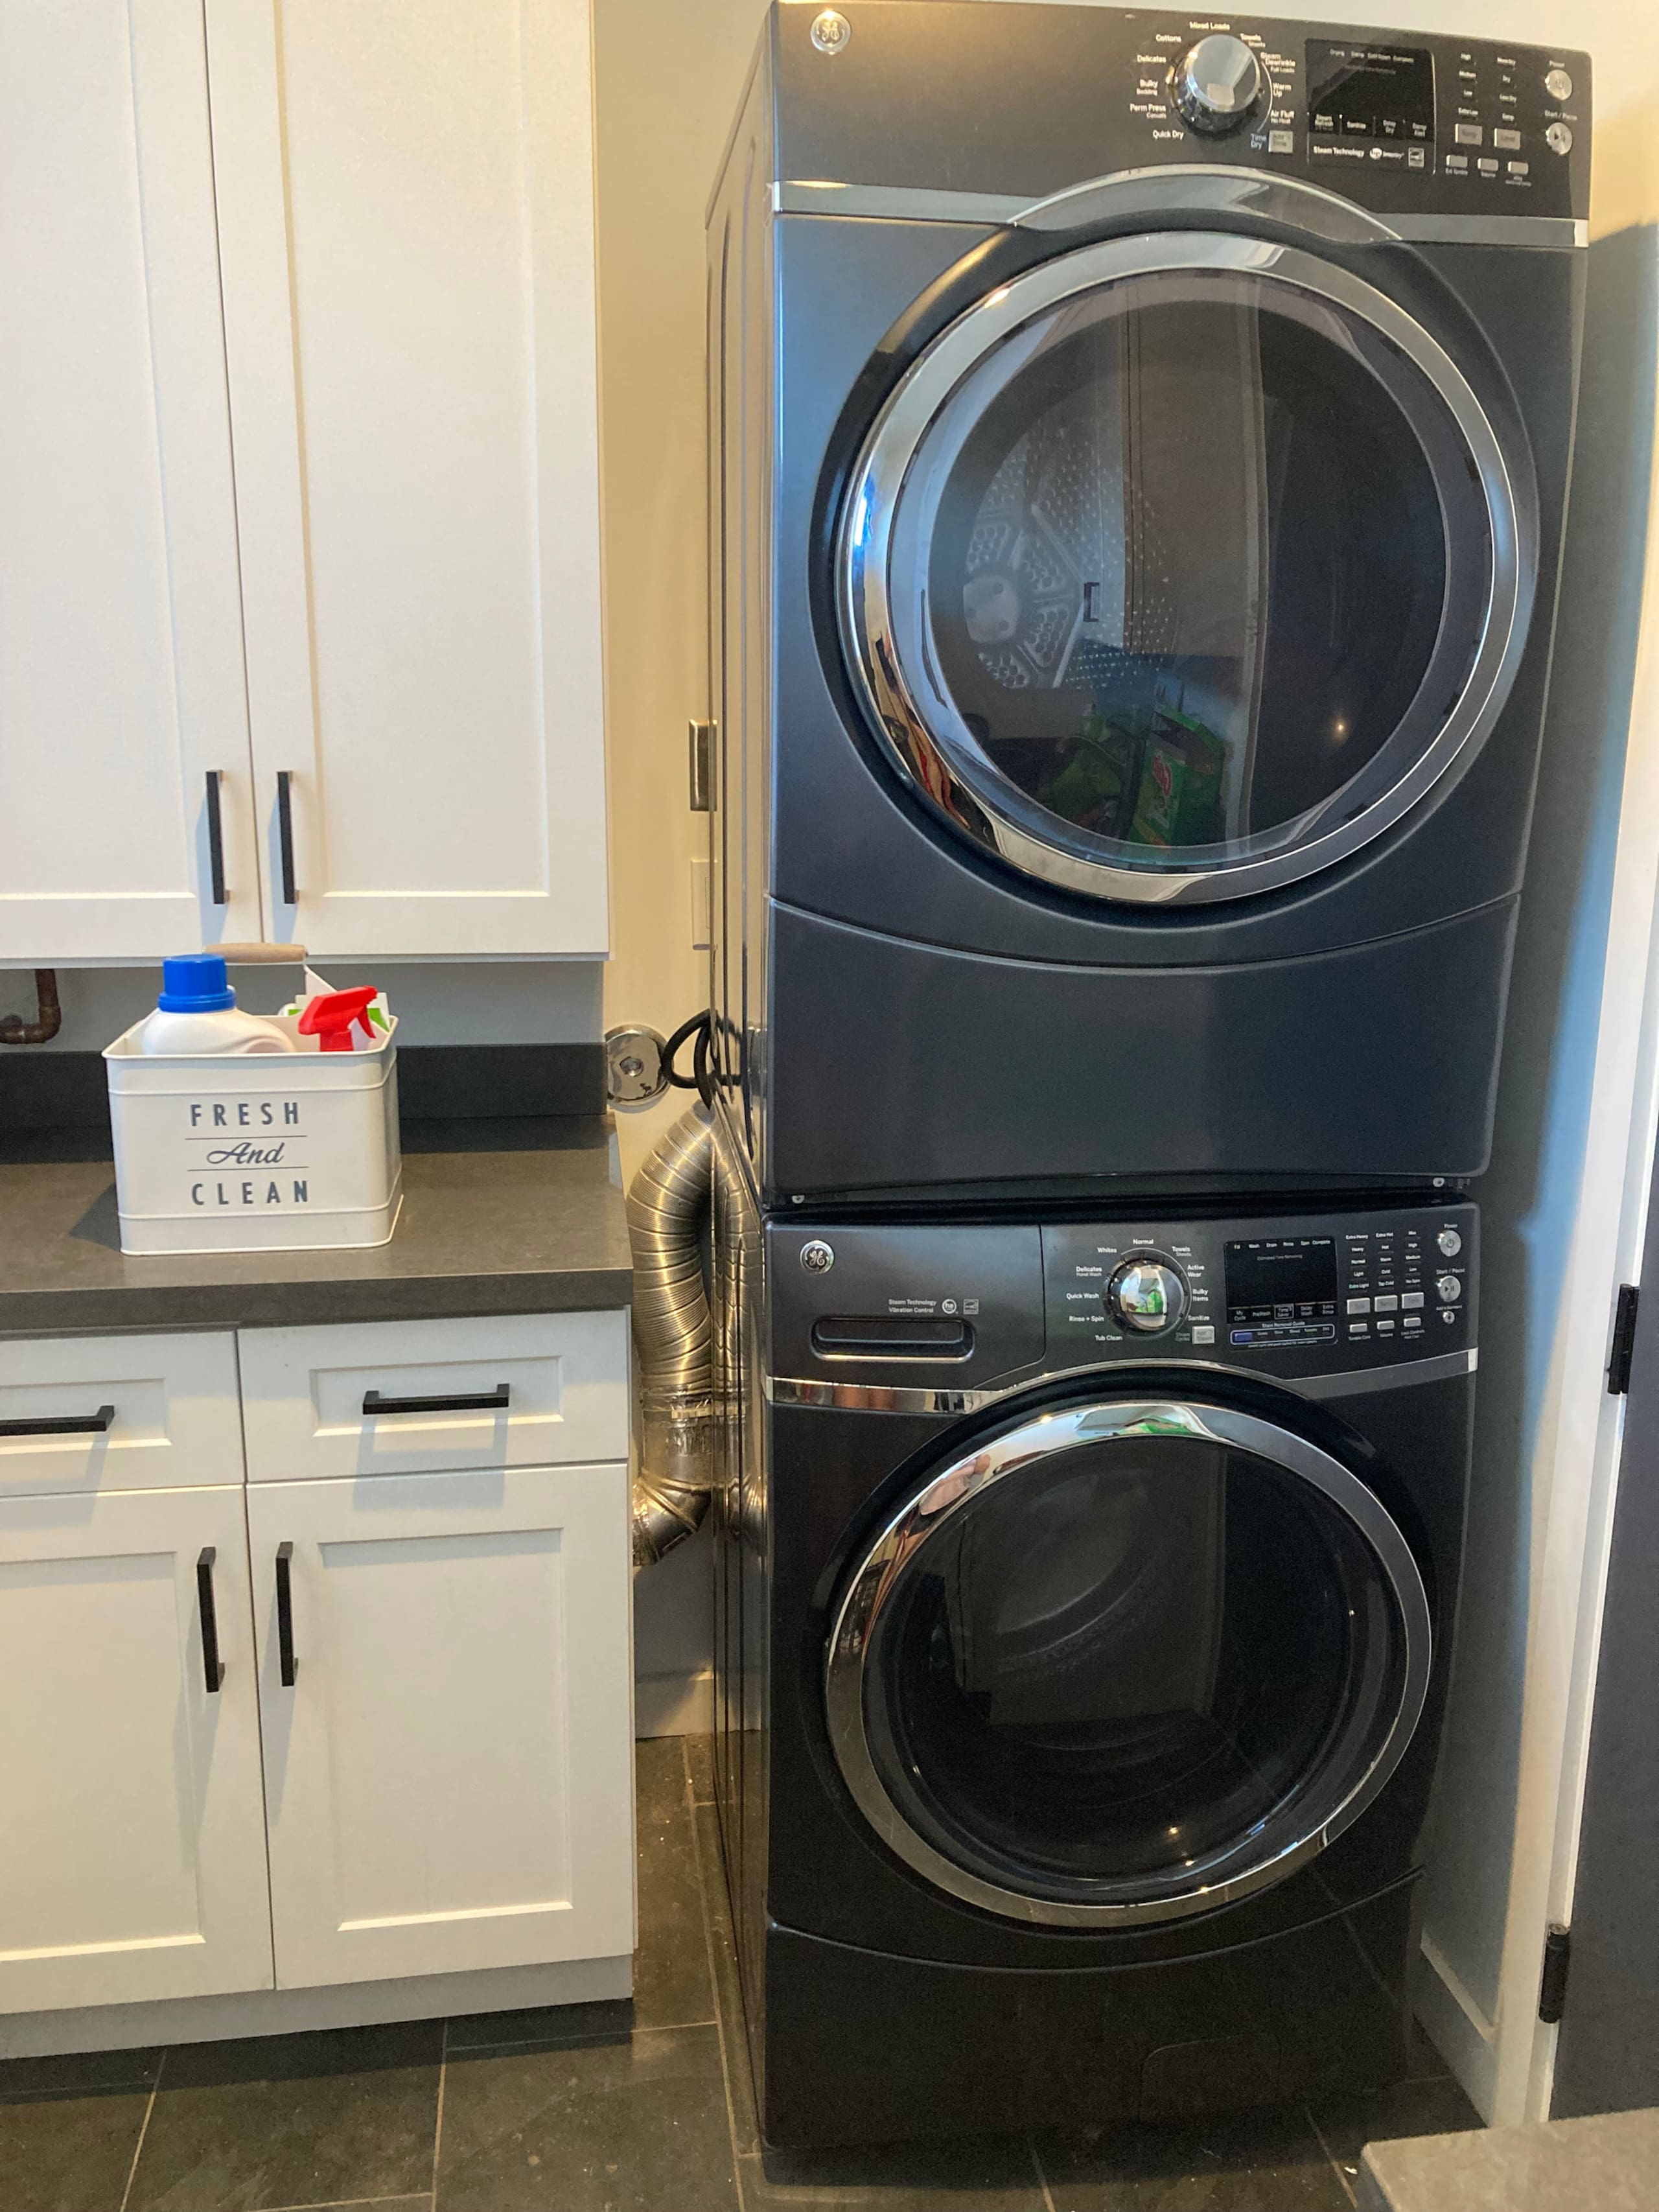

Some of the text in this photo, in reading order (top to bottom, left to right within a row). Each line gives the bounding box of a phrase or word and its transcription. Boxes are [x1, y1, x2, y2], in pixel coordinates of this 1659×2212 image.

[1155, 34, 1181, 43] Cottons
[1240, 33, 1261, 41] Towels
[1140, 79, 1158, 88] Bulky
[1273, 82, 1292, 91] Warm
[1148, 104, 1166, 112] Press
[1280, 110, 1295, 119] Fluff
[1153, 130, 1184, 139] Quick Dry
[1251, 141, 1262, 150] Dry
[1314, 145, 1332, 154] Steam
[1333, 146, 1365, 158] Technology
[190, 1102, 299, 1126] FRESH
[206, 1141, 285, 1165] And
[191, 1180, 308, 1205] CLEAN
